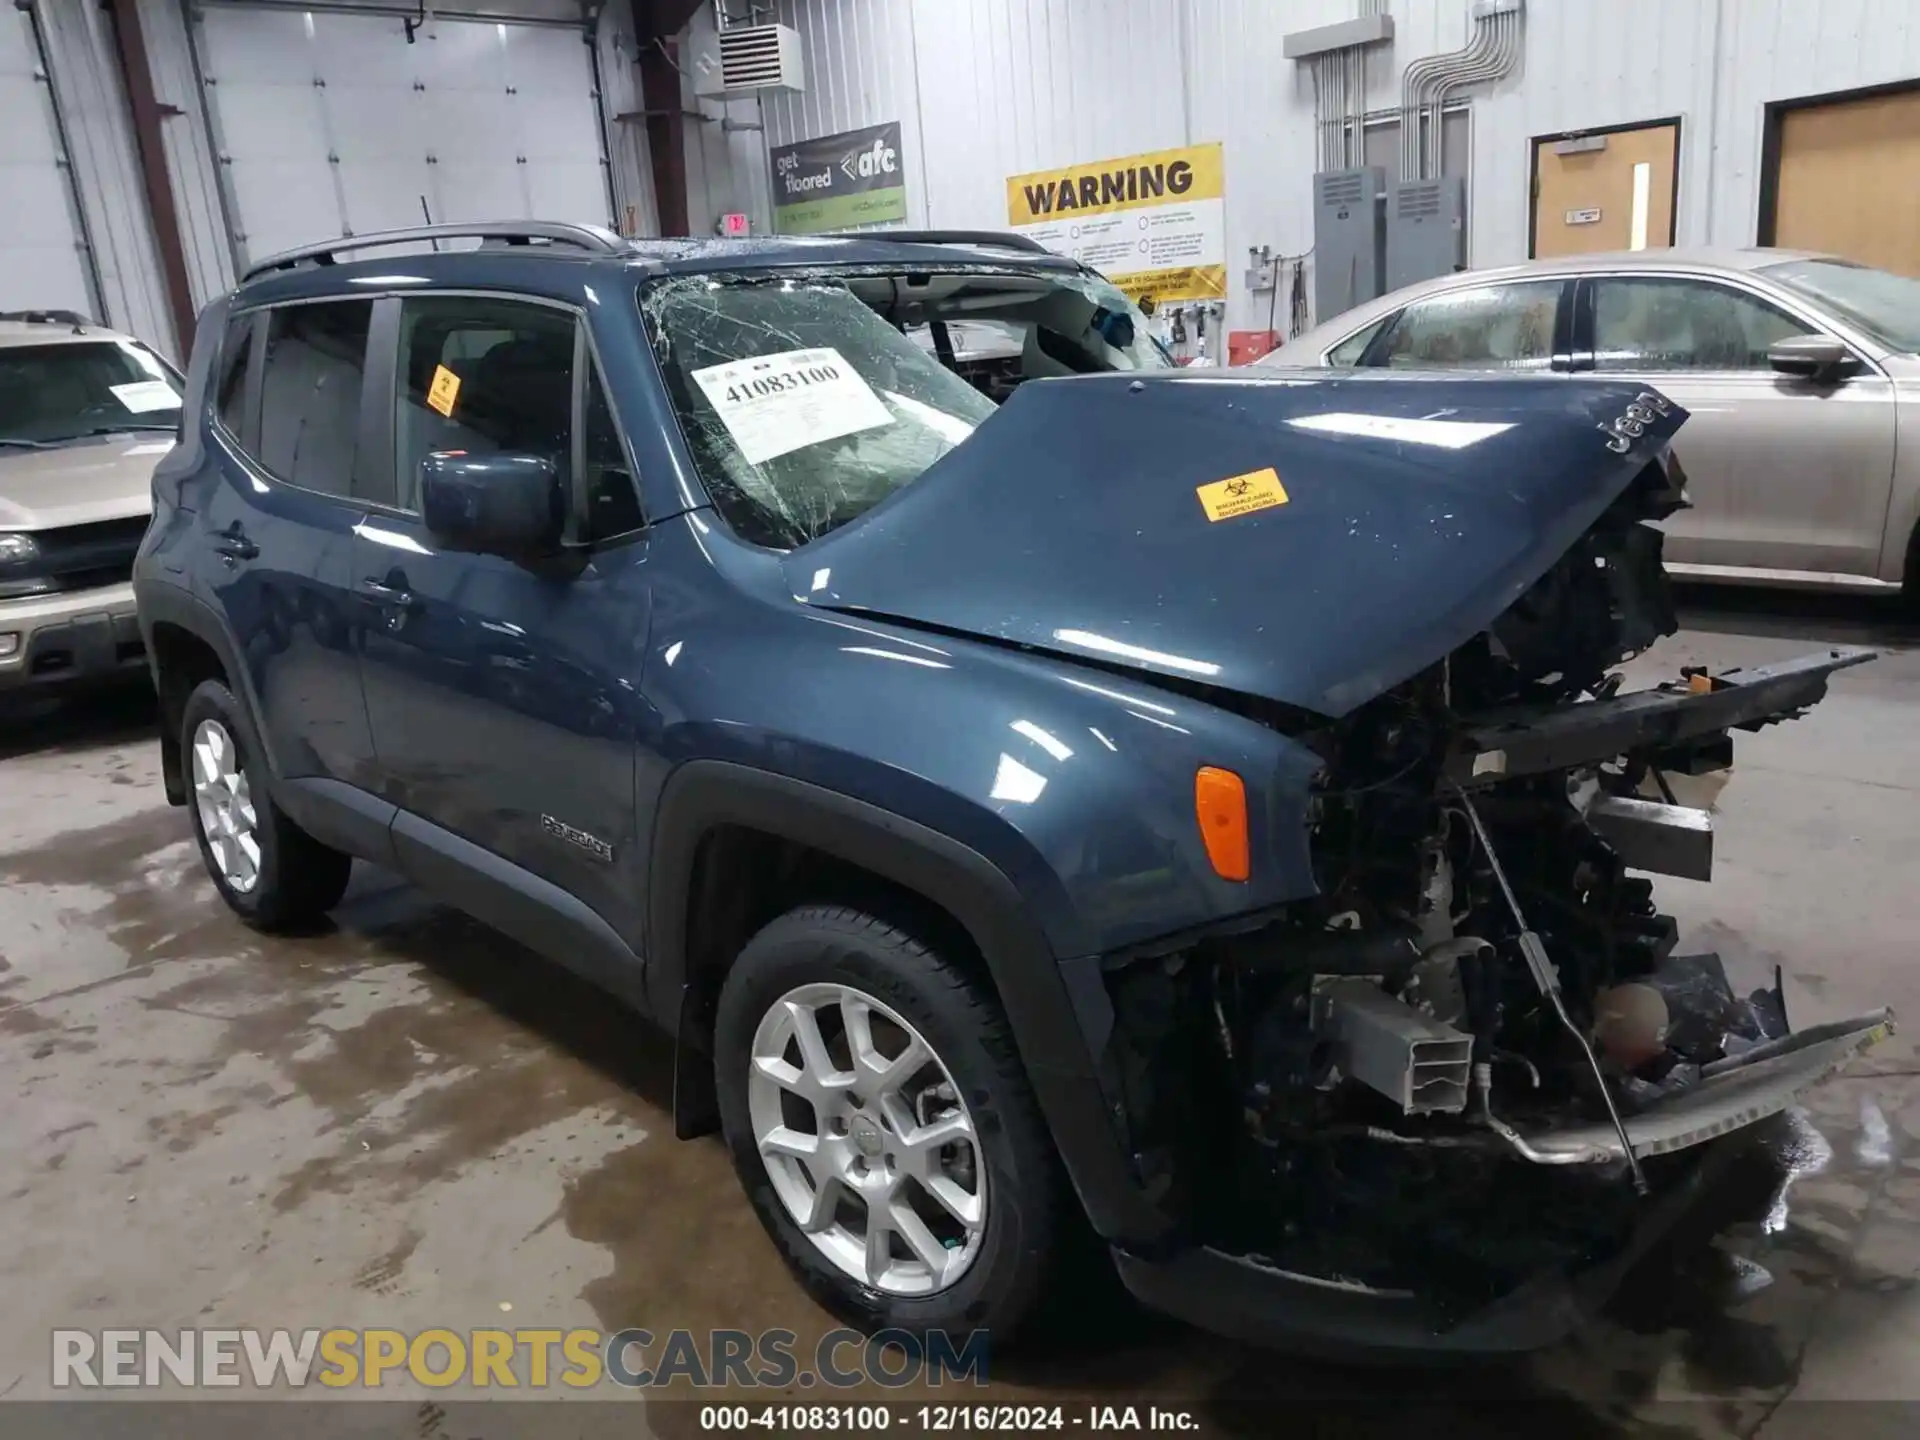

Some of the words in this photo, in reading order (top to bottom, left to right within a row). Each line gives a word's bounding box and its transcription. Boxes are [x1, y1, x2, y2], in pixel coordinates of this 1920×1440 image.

[777, 151, 799, 175] get
[858, 139, 896, 178] afc
[785, 166, 832, 193] floored
[1023, 160, 1194, 216] WARNING
[725, 365, 840, 403] 41083100
[1596, 391, 1669, 453] Jeep
